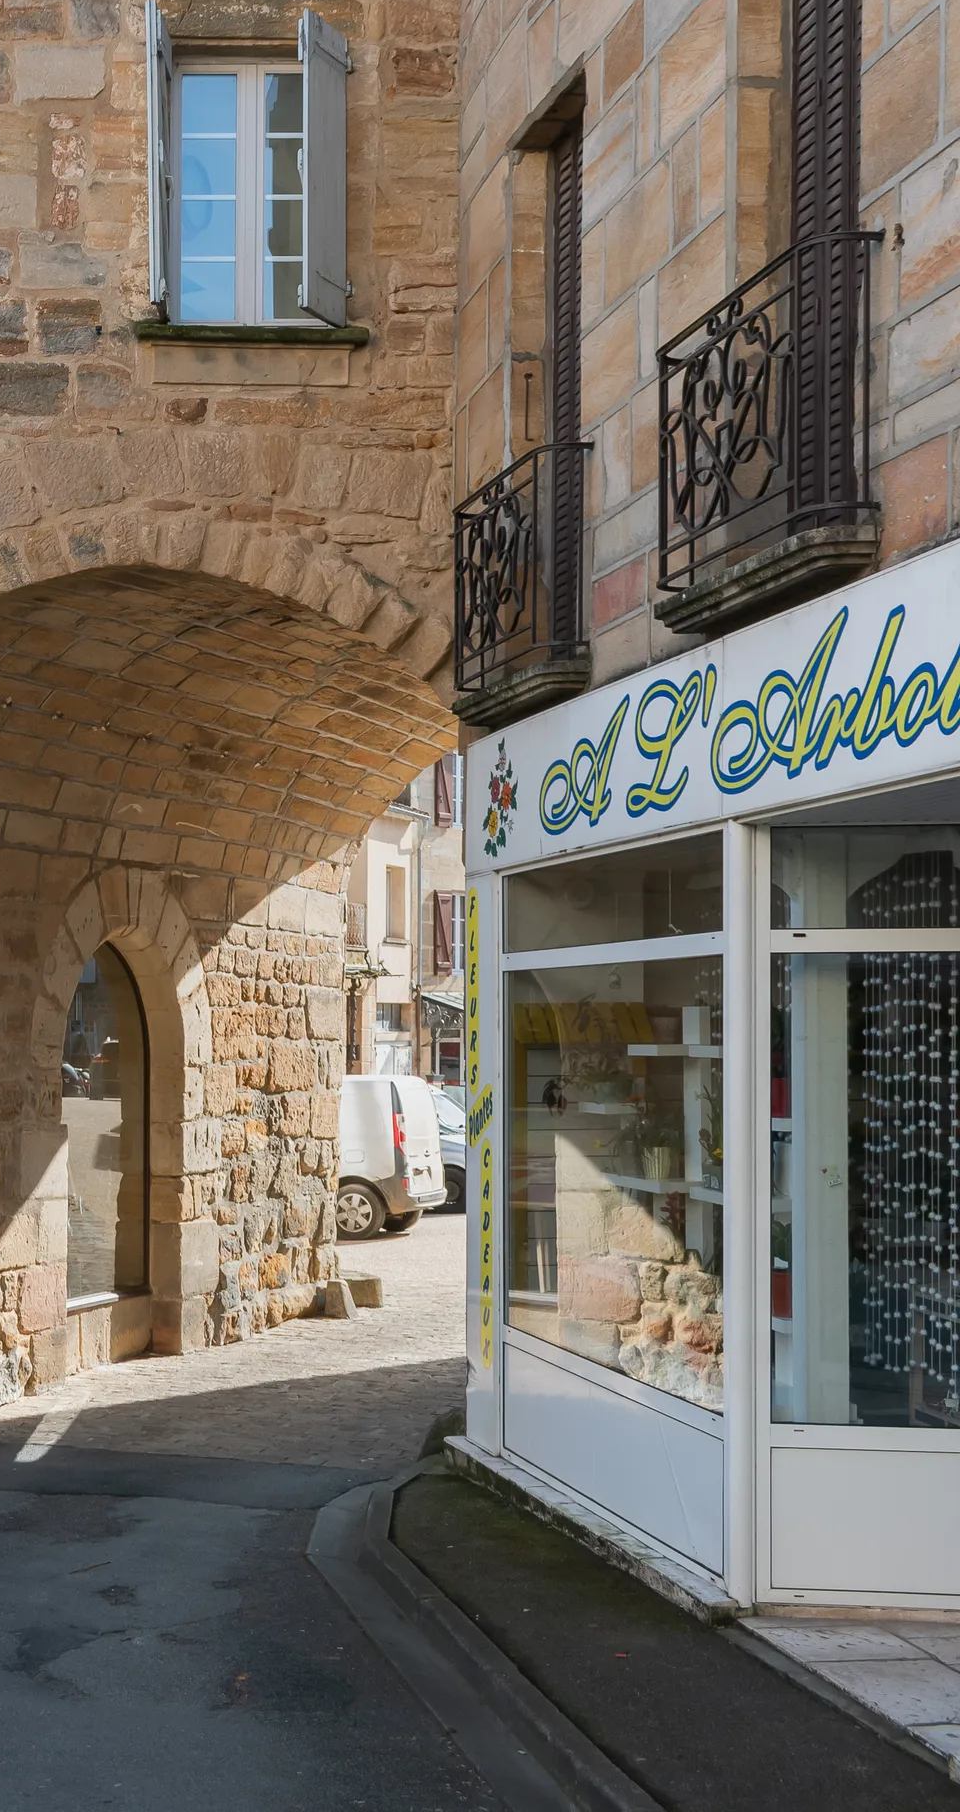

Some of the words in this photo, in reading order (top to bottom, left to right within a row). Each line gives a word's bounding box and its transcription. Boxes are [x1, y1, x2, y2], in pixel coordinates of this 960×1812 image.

[539, 693, 630, 838] A
[469, 895, 478, 1086] FLEURS
[468, 1090, 493, 1147] Plantes
[482, 1148, 491, 1360] CADEAUX
